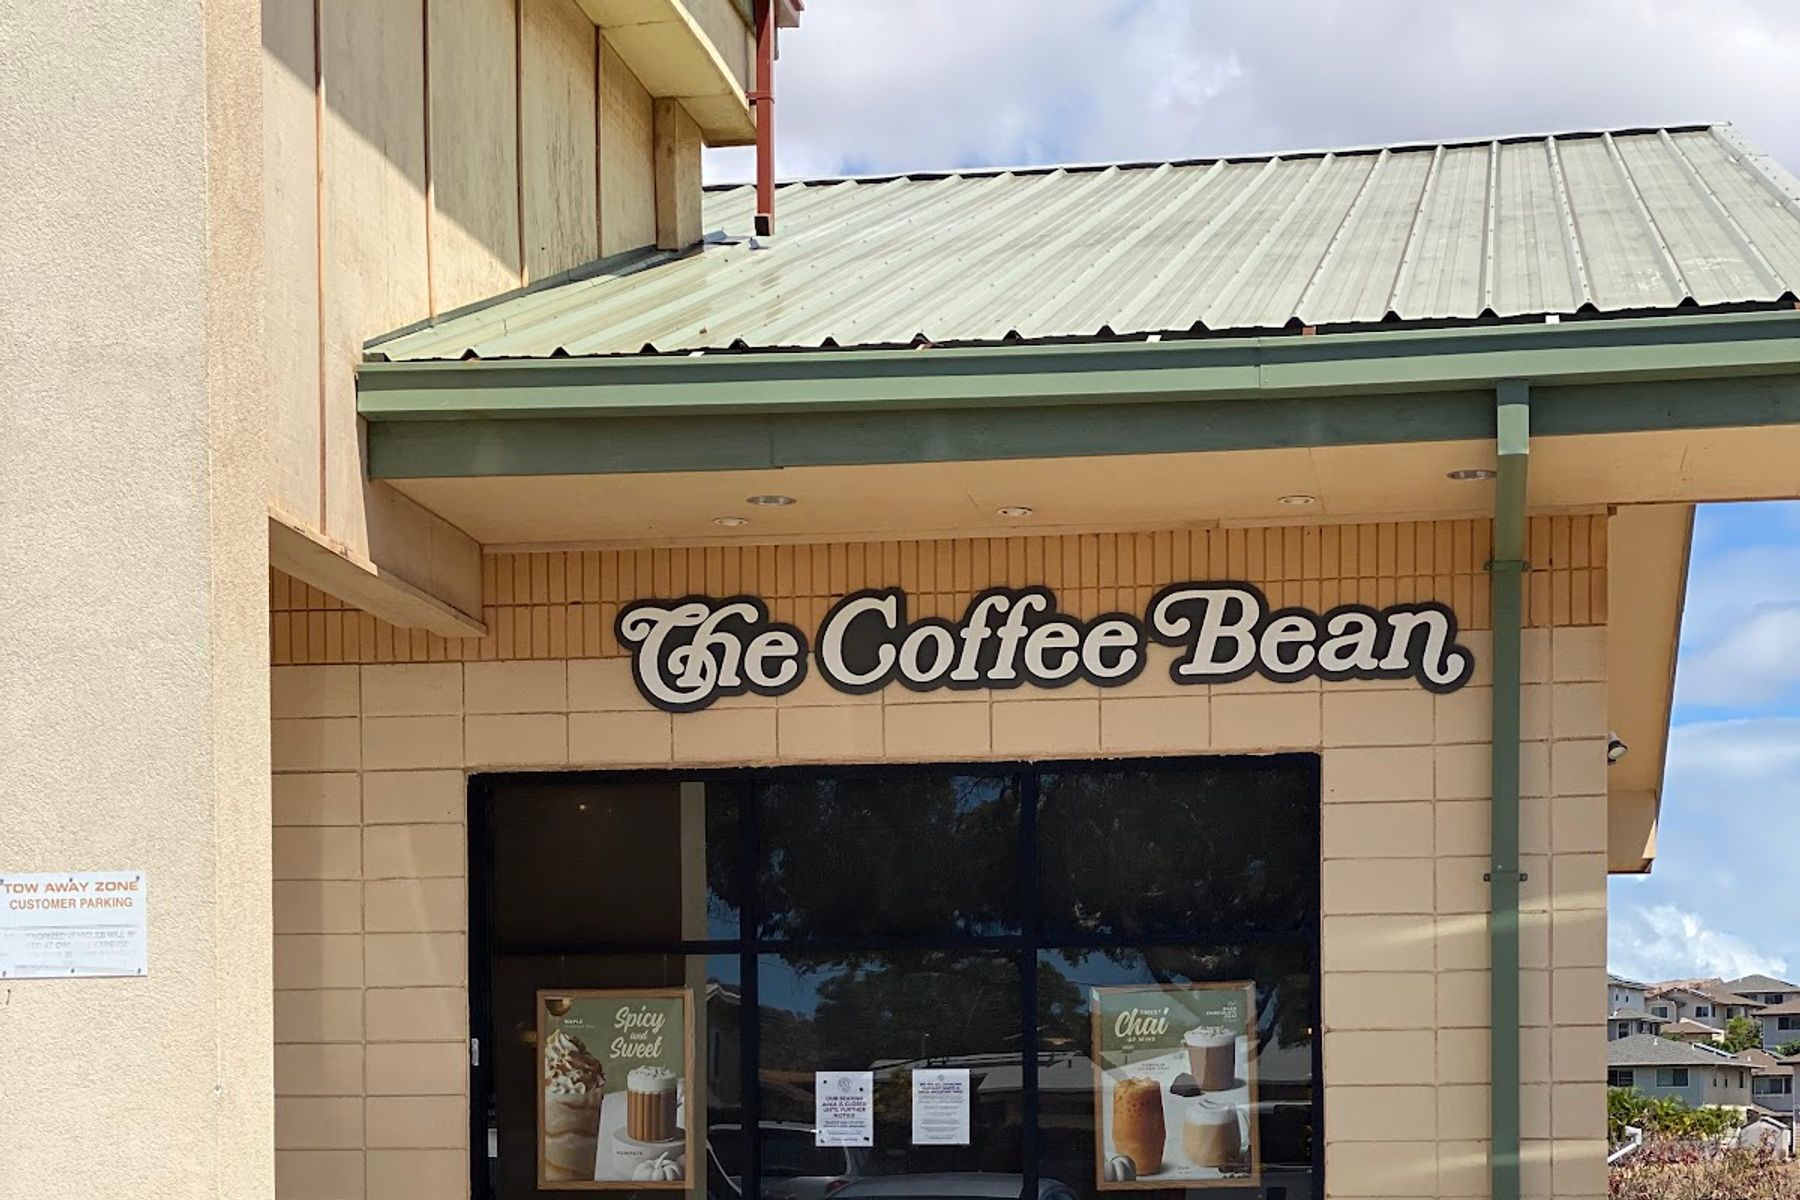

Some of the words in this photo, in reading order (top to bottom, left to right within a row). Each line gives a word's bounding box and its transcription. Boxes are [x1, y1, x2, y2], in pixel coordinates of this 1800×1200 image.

[620, 601, 799, 704] The
[820, 594, 1139, 687] Coffee
[1153, 588, 1466, 687] Bean
[4, 883, 39, 894] TOW
[44, 881, 89, 892] AWAY
[94, 880, 139, 892] ZONE
[9, 898, 77, 910] CUSTOMER
[79, 896, 133, 909] PARKING
[613, 1005, 666, 1034] Spicy
[1114, 1006, 1170, 1038] Chai
[629, 1029, 648, 1041] and
[609, 1036, 663, 1059] Sweet
